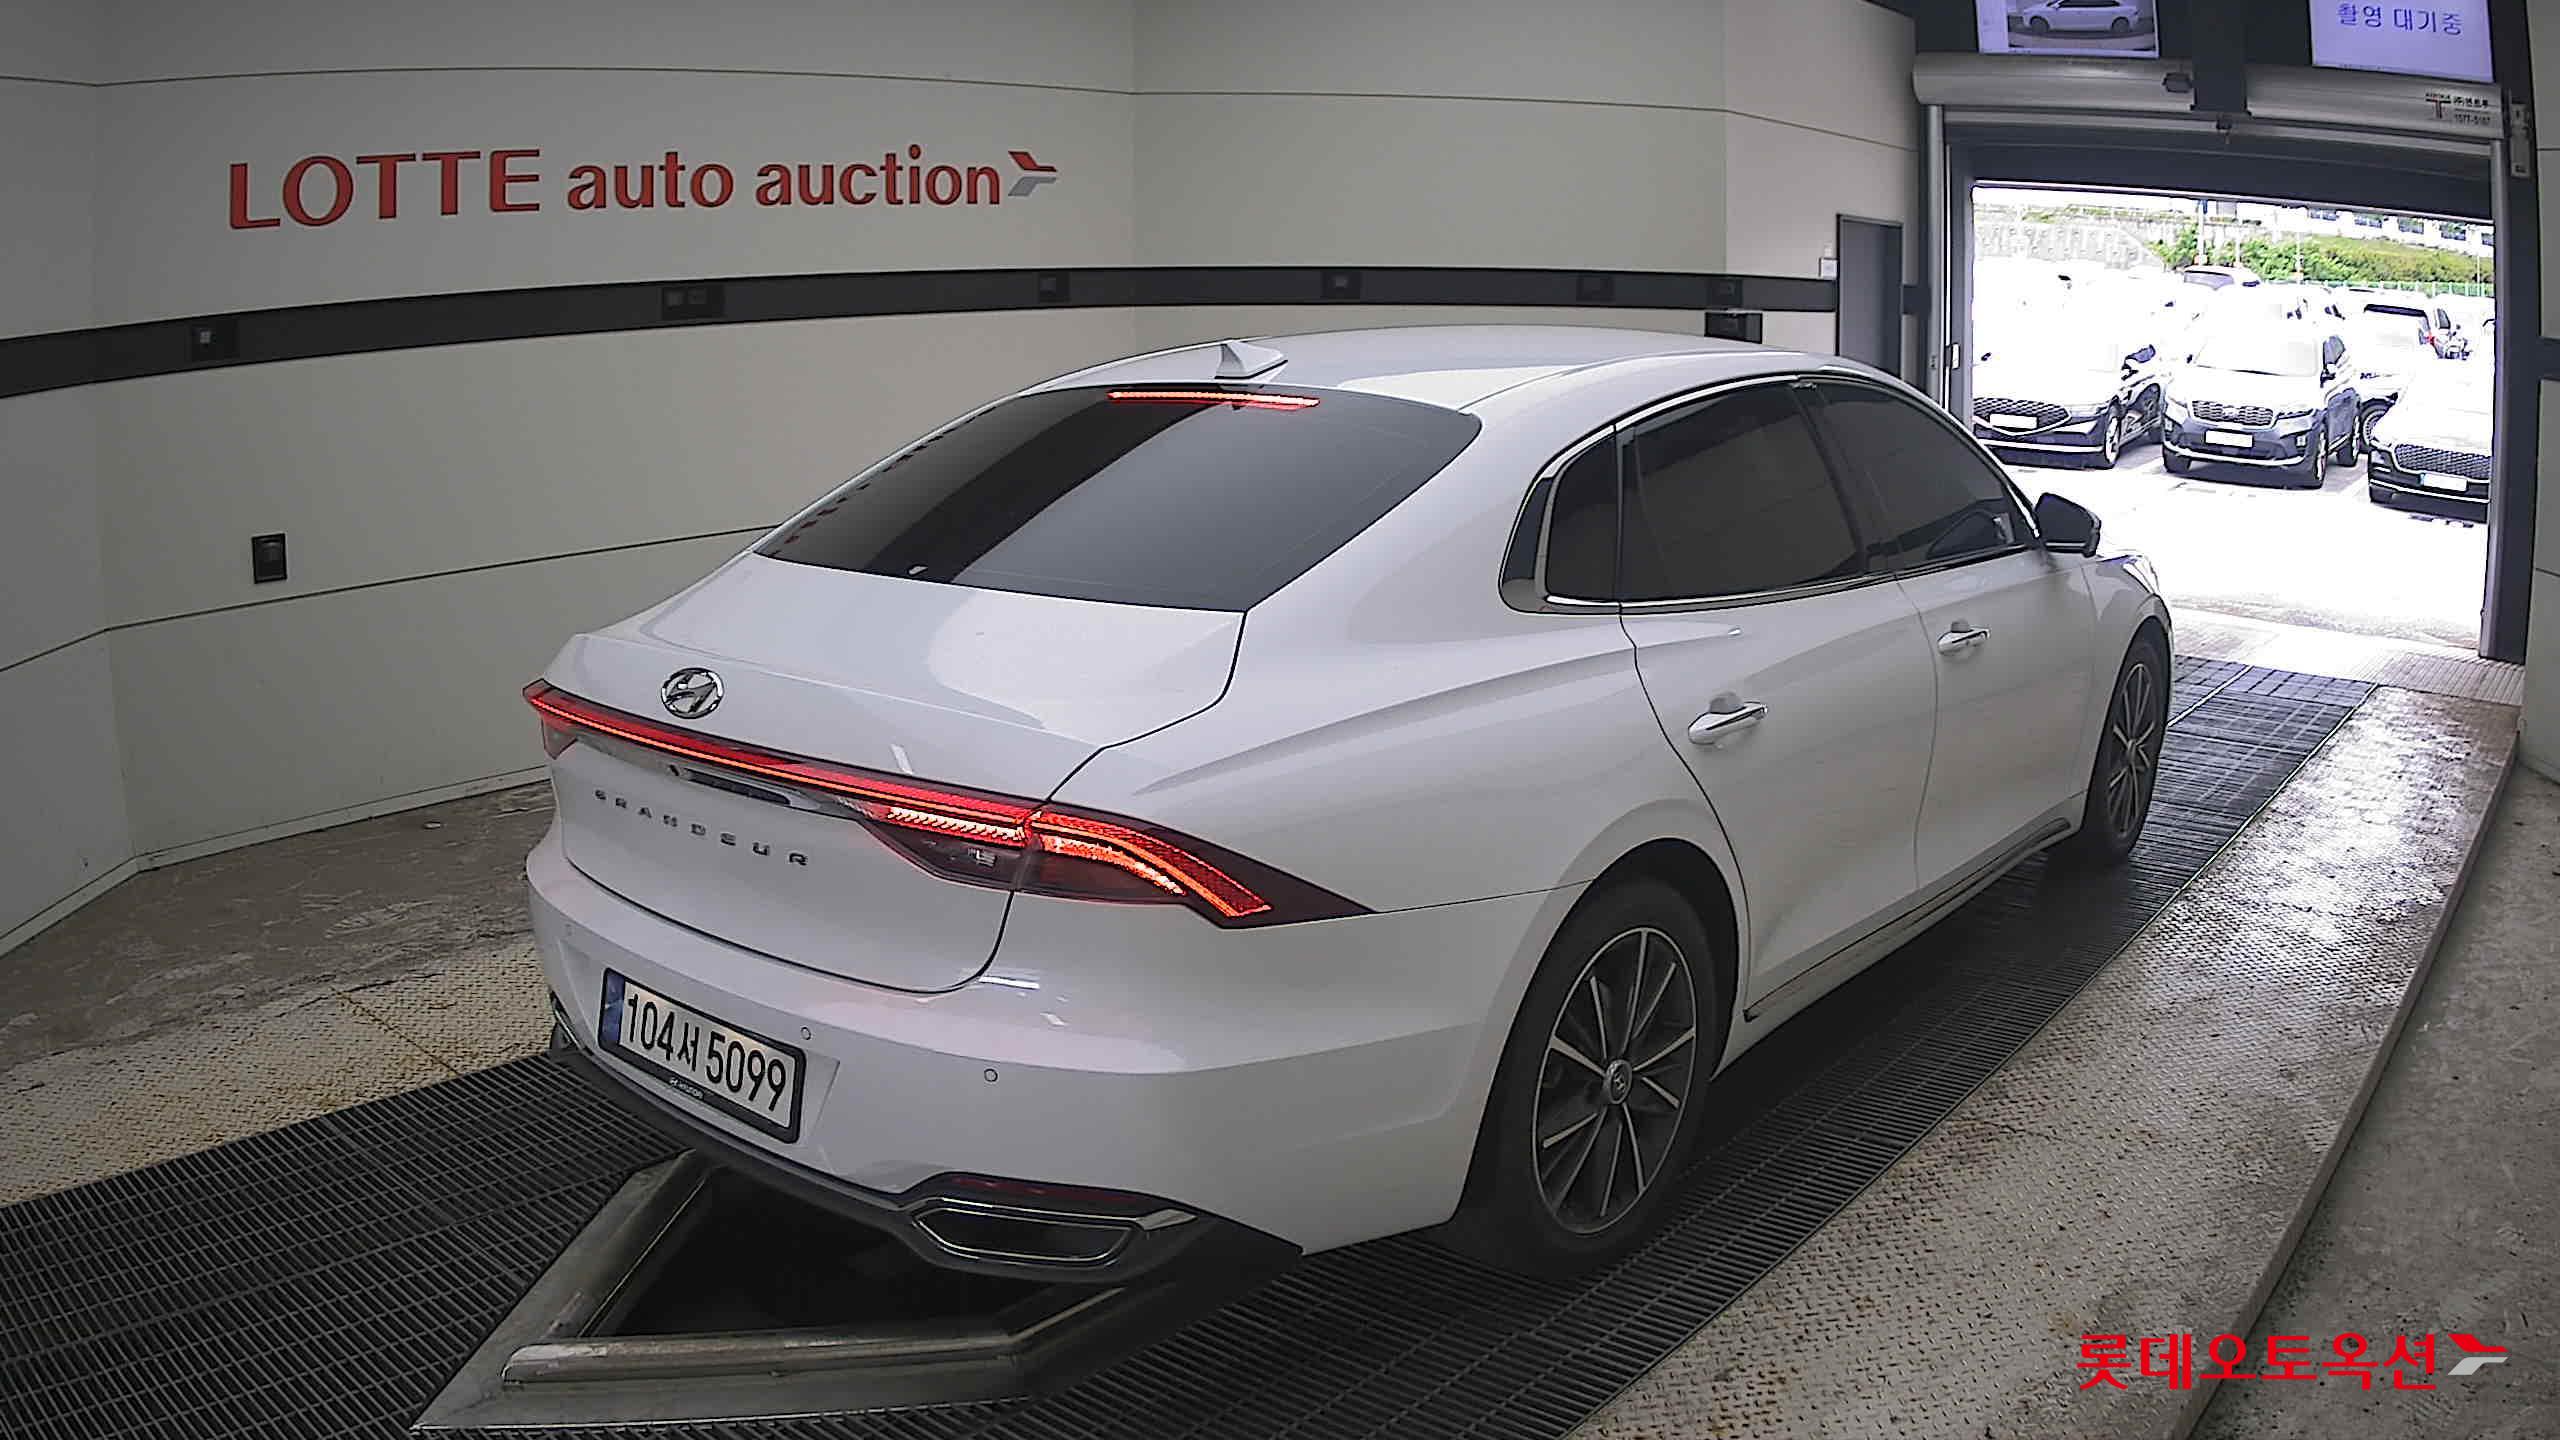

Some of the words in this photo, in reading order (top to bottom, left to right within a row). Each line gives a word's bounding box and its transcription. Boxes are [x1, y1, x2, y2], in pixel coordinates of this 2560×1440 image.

[2338, 3, 2383, 28] 촬영
[2393, 8, 2462, 36] 대기중
[229, 148, 539, 229] LOTTE
[567, 150, 735, 210] auto
[755, 145, 1002, 207] auction
[627, 993, 700, 1073] 104서
[705, 1030, 787, 1112] 5099
